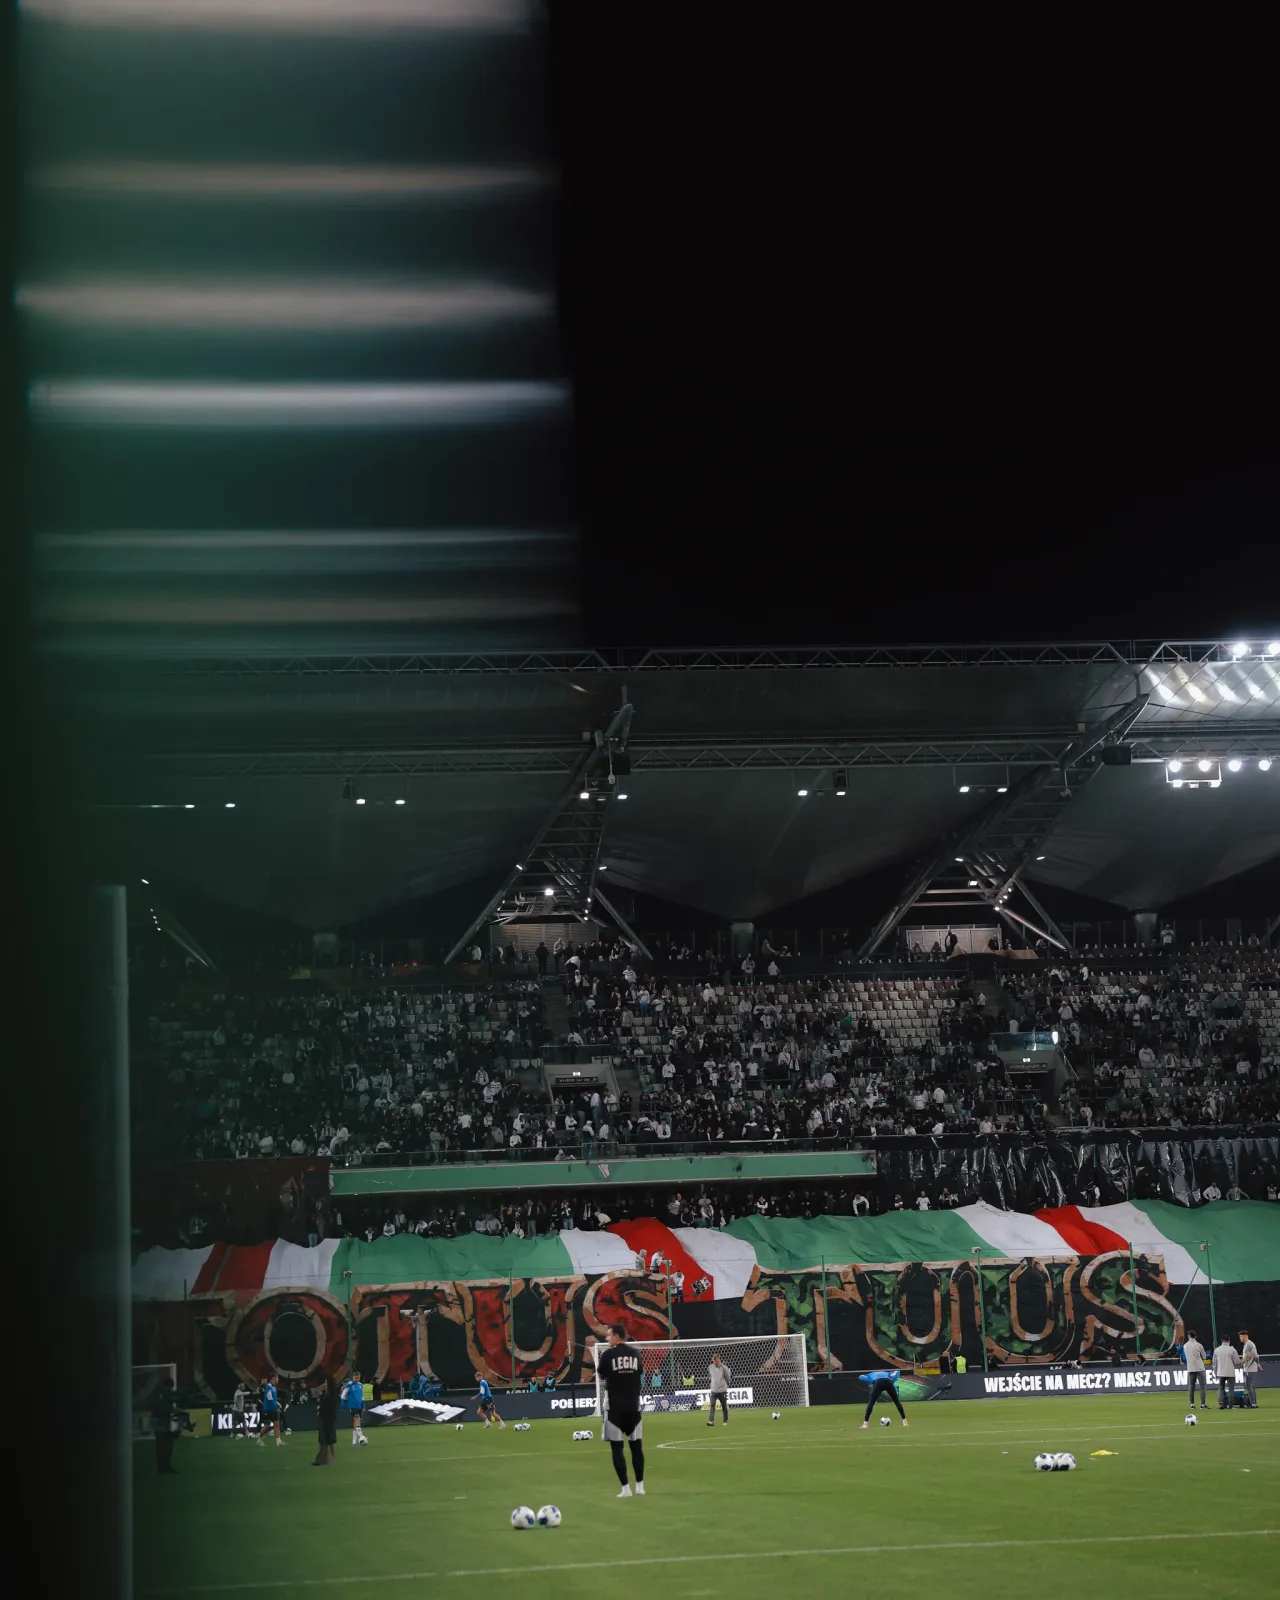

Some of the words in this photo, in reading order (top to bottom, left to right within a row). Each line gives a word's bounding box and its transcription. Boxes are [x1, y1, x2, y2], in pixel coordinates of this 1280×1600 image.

[741, 1250, 1185, 1373] TUUS
[612, 1356, 638, 1371] LEGIA
[984, 1373, 1042, 1392] WEJŚCIE
[1045, 1375, 1063, 1390] NA
[1066, 1373, 1111, 1389] MECZ?
[1113, 1371, 1151, 1388] MASZ
[1154, 1370, 1171, 1386] TO
[1173, 1370, 1188, 1385] W
